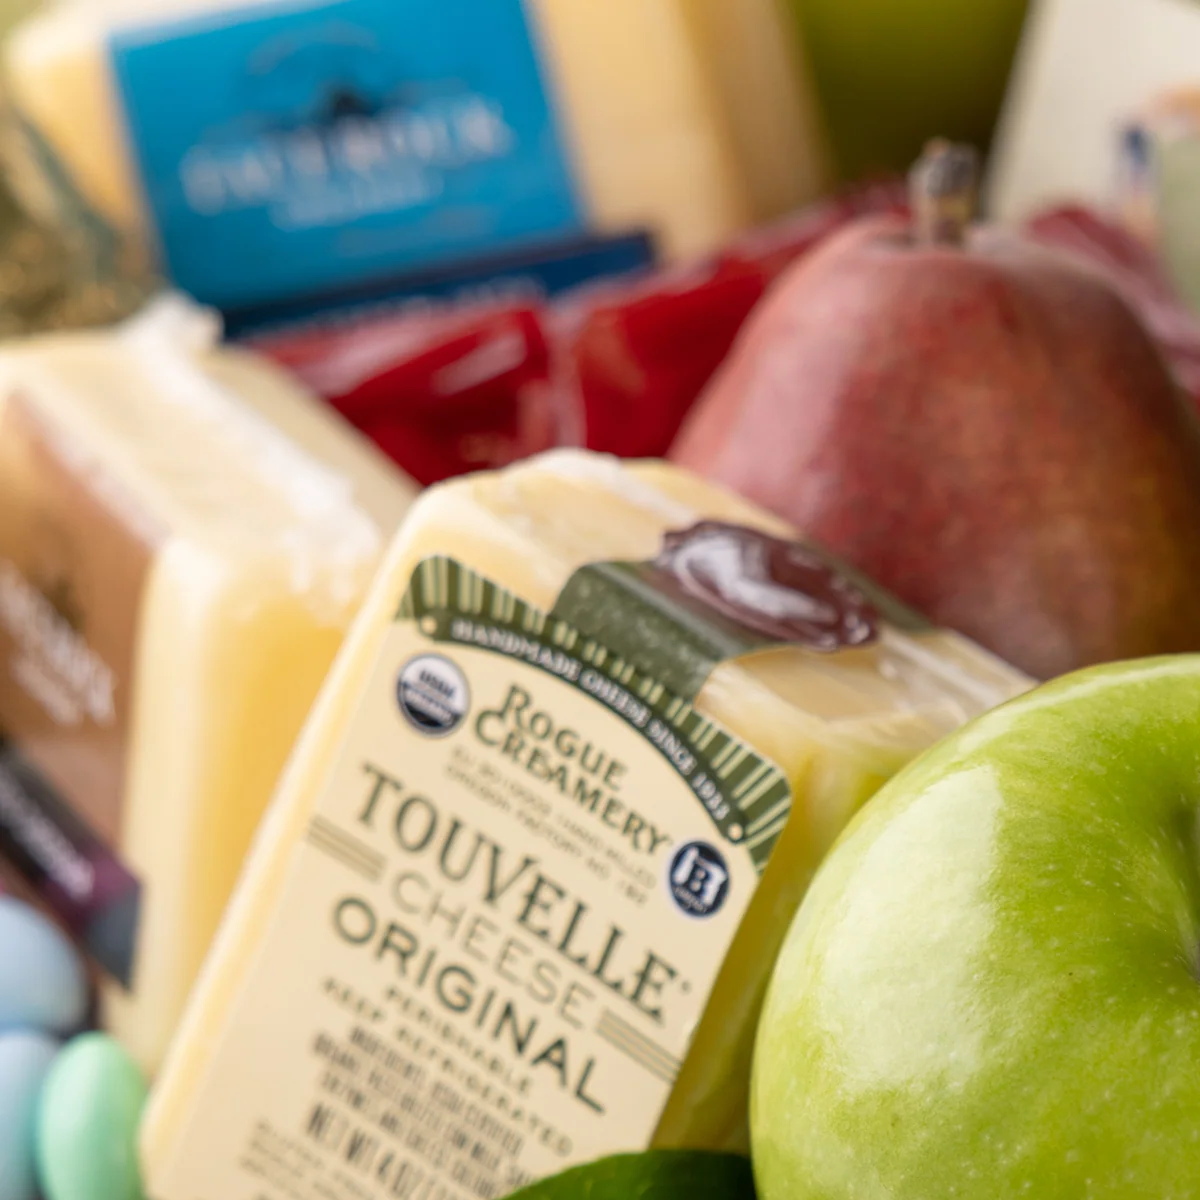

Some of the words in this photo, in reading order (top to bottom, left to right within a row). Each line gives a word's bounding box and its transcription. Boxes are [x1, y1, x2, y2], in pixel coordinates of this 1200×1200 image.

[451, 618, 583, 682] HANDMADE
[579, 668, 651, 728] CHEESE
[647, 719, 698, 776] SINCE
[499, 683, 629, 792] ROGUE
[473, 708, 670, 857] CREAMERY
[358, 760, 681, 1028] TOUVELLE
[392, 869, 597, 1030] CHEESE
[333, 897, 606, 1117] ORIGINAL
